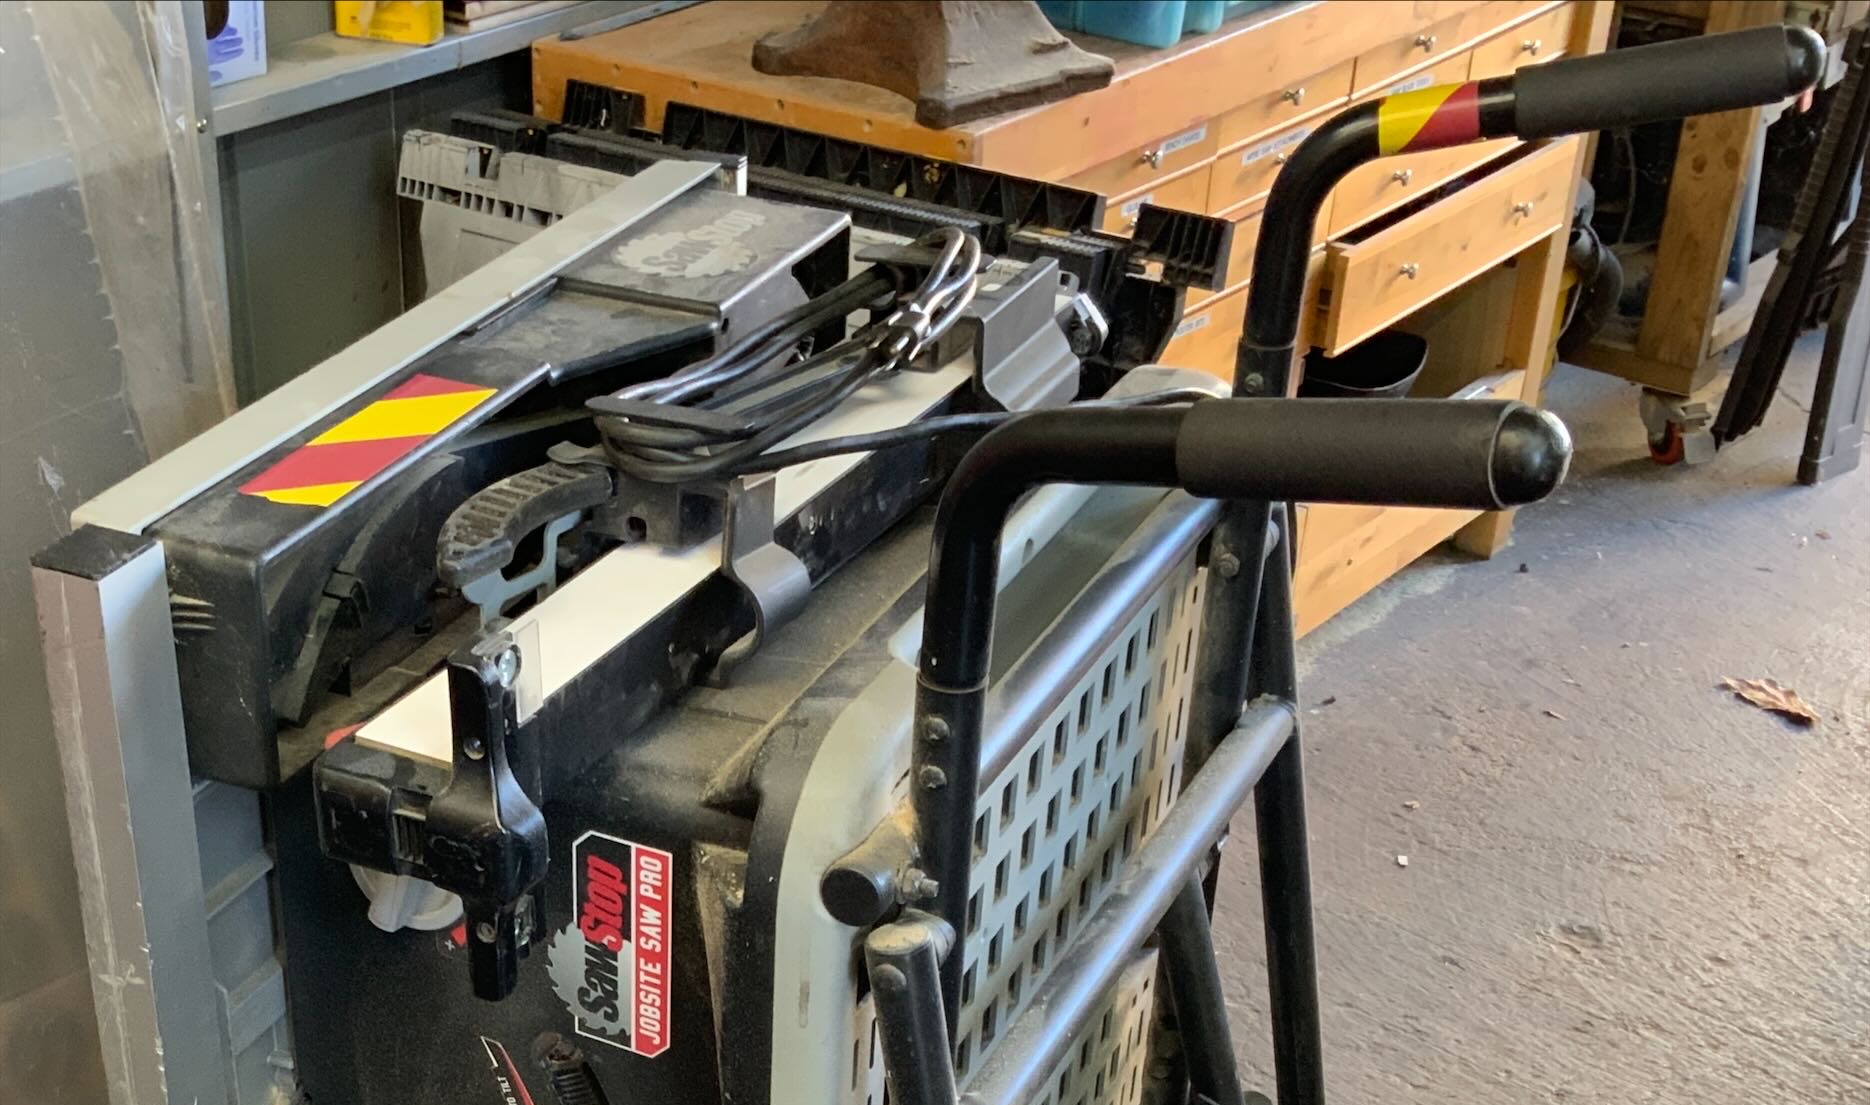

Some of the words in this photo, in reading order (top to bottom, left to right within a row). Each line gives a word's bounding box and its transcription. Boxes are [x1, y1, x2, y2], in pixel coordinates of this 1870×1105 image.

[639, 855, 663, 900] PRO
[577, 853, 627, 1024] SawStop
[639, 904, 663, 953] SAW
[639, 957, 662, 1045] JOBSITE
[497, 1076, 512, 1093] TILT
